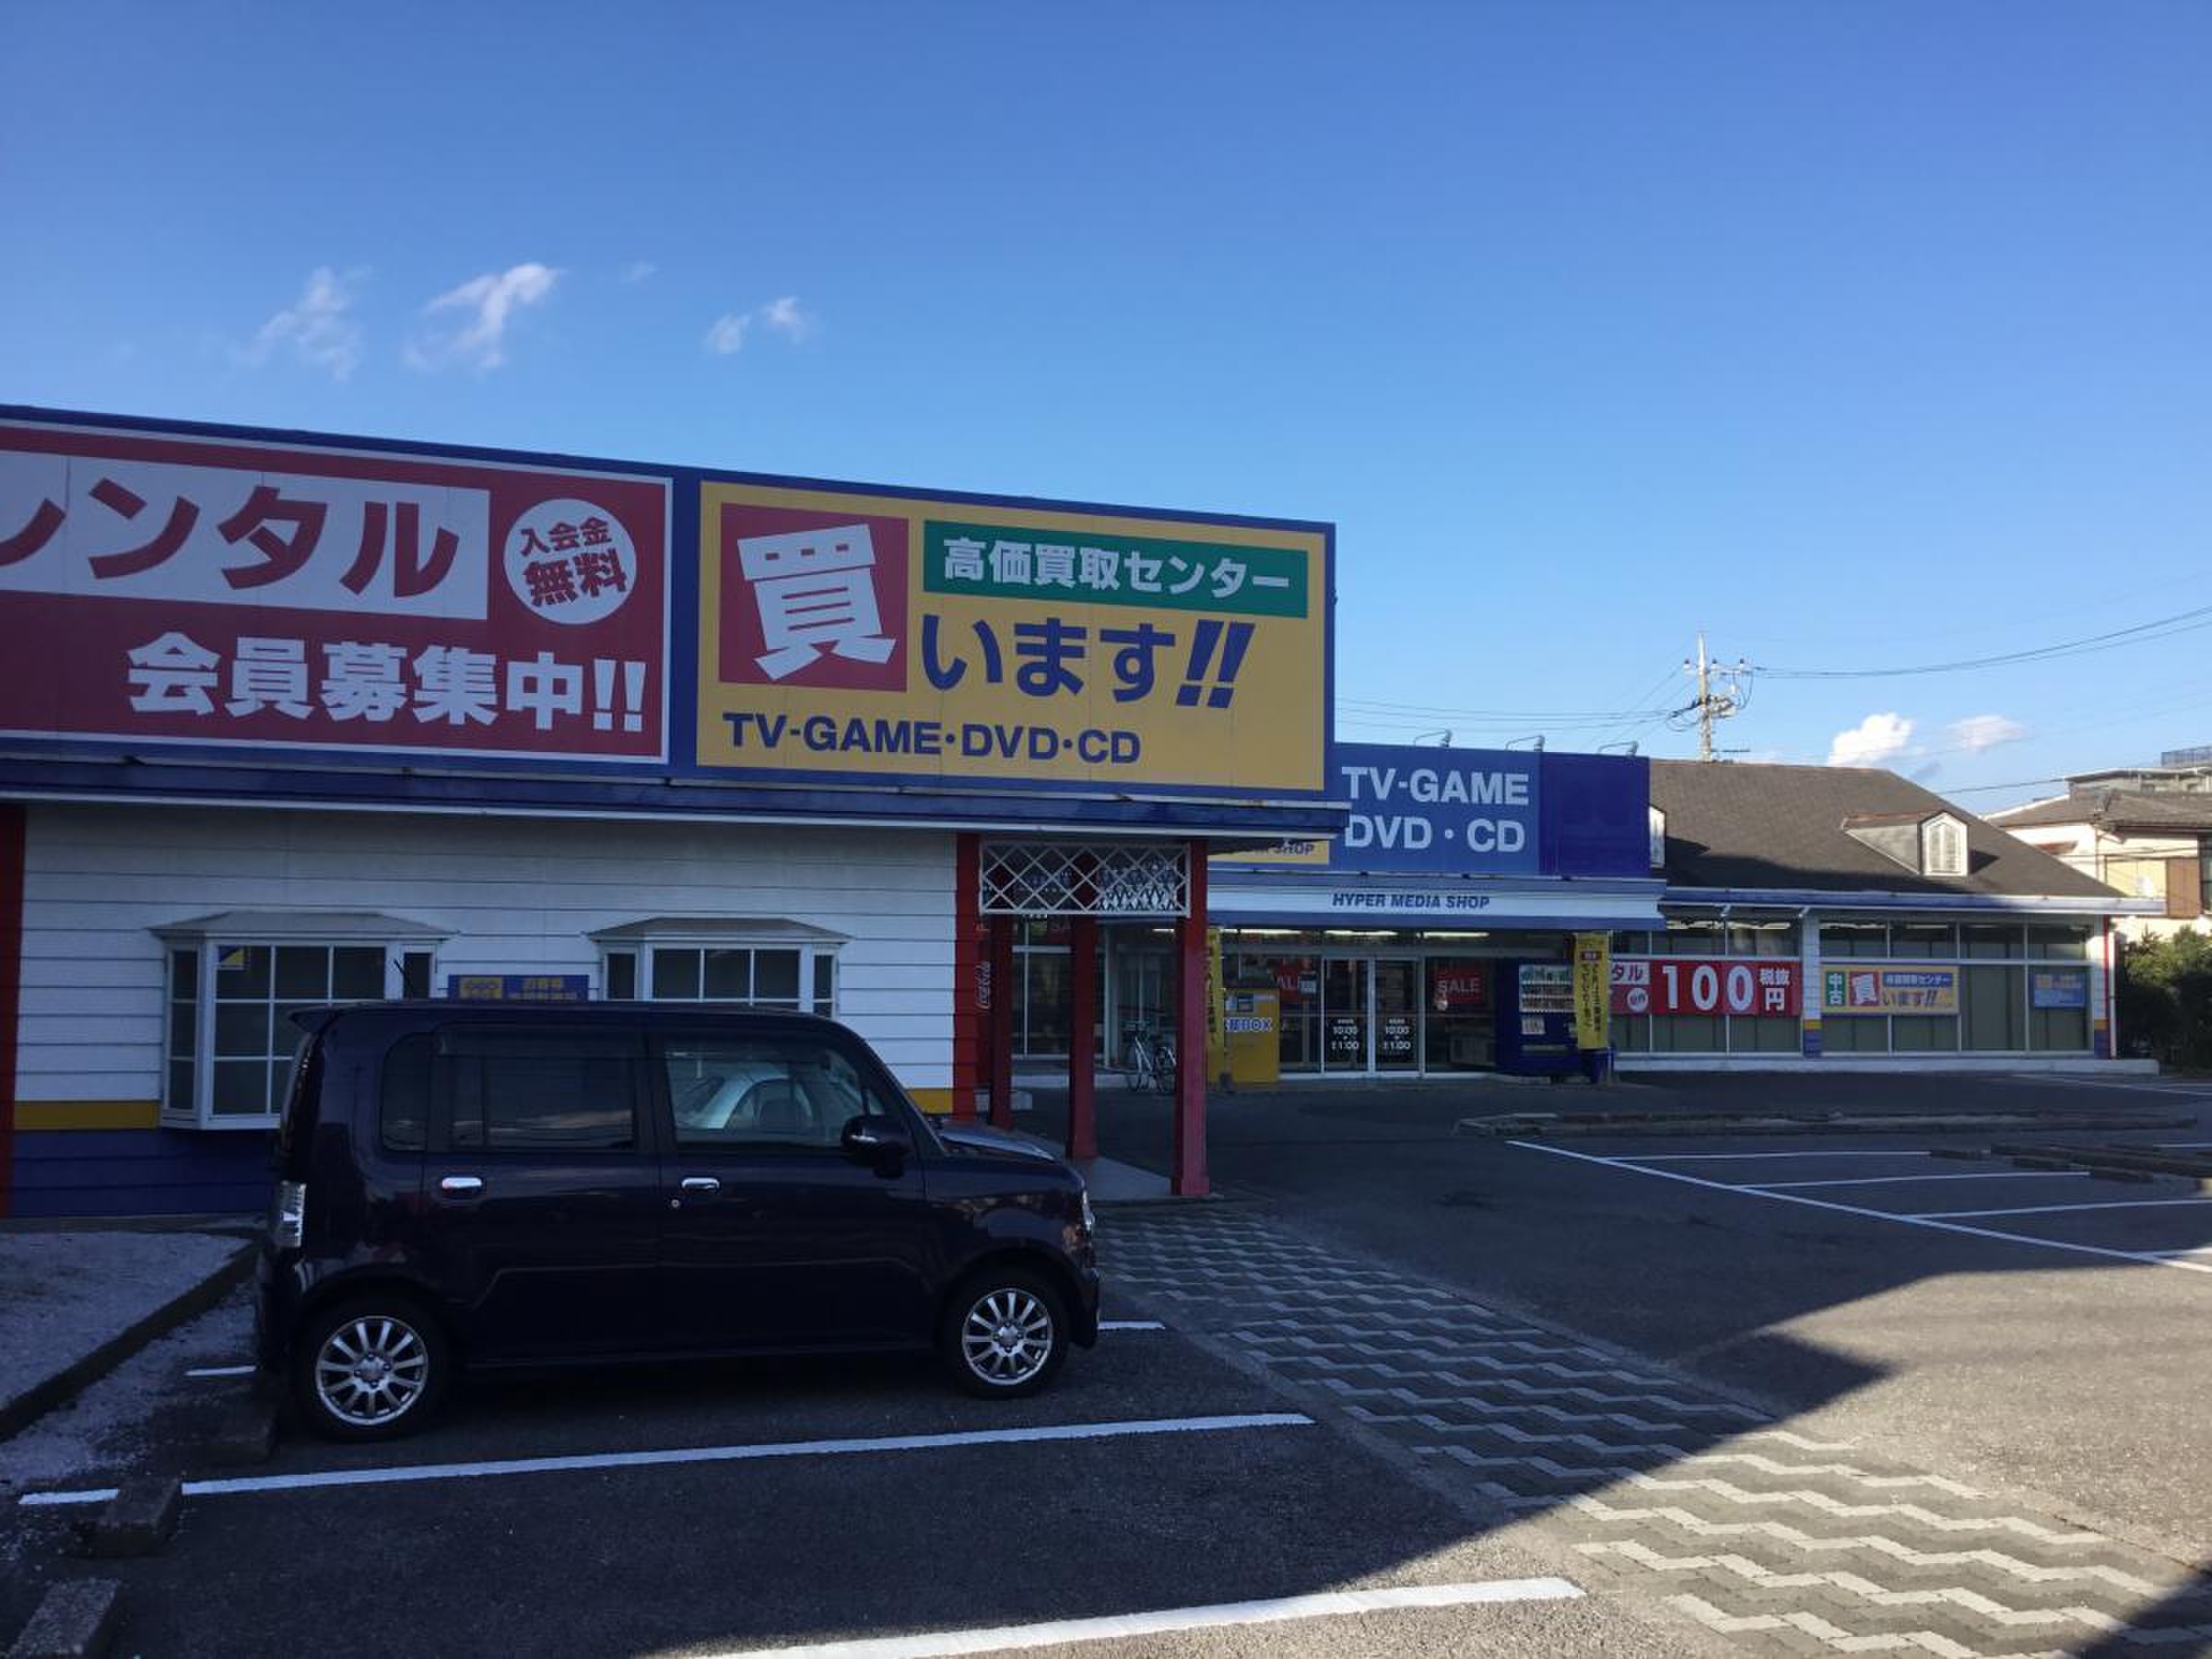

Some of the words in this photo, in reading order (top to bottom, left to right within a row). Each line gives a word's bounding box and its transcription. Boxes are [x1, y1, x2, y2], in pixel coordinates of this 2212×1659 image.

[519, 516, 612, 557] 入会金
[522, 547, 628, 608] 無料
[943, 536, 1289, 598] 高価買取センター
[737, 523, 897, 682] 買
[126, 631, 646, 733] 会員募集中!!
[922, 614, 1256, 710] います!!
[1341, 766, 1530, 806] TV-GAME
[1332, 892, 1386, 908] HYPER
[1390, 893, 1441, 909] MEDIA
[1445, 894, 1490, 911] SHOP
[1438, 977, 1480, 994] SALE
[1662, 964, 1755, 1012] 100
[1765, 987, 1785, 1011] 円
[1828, 972, 1844, 1005] 中古
